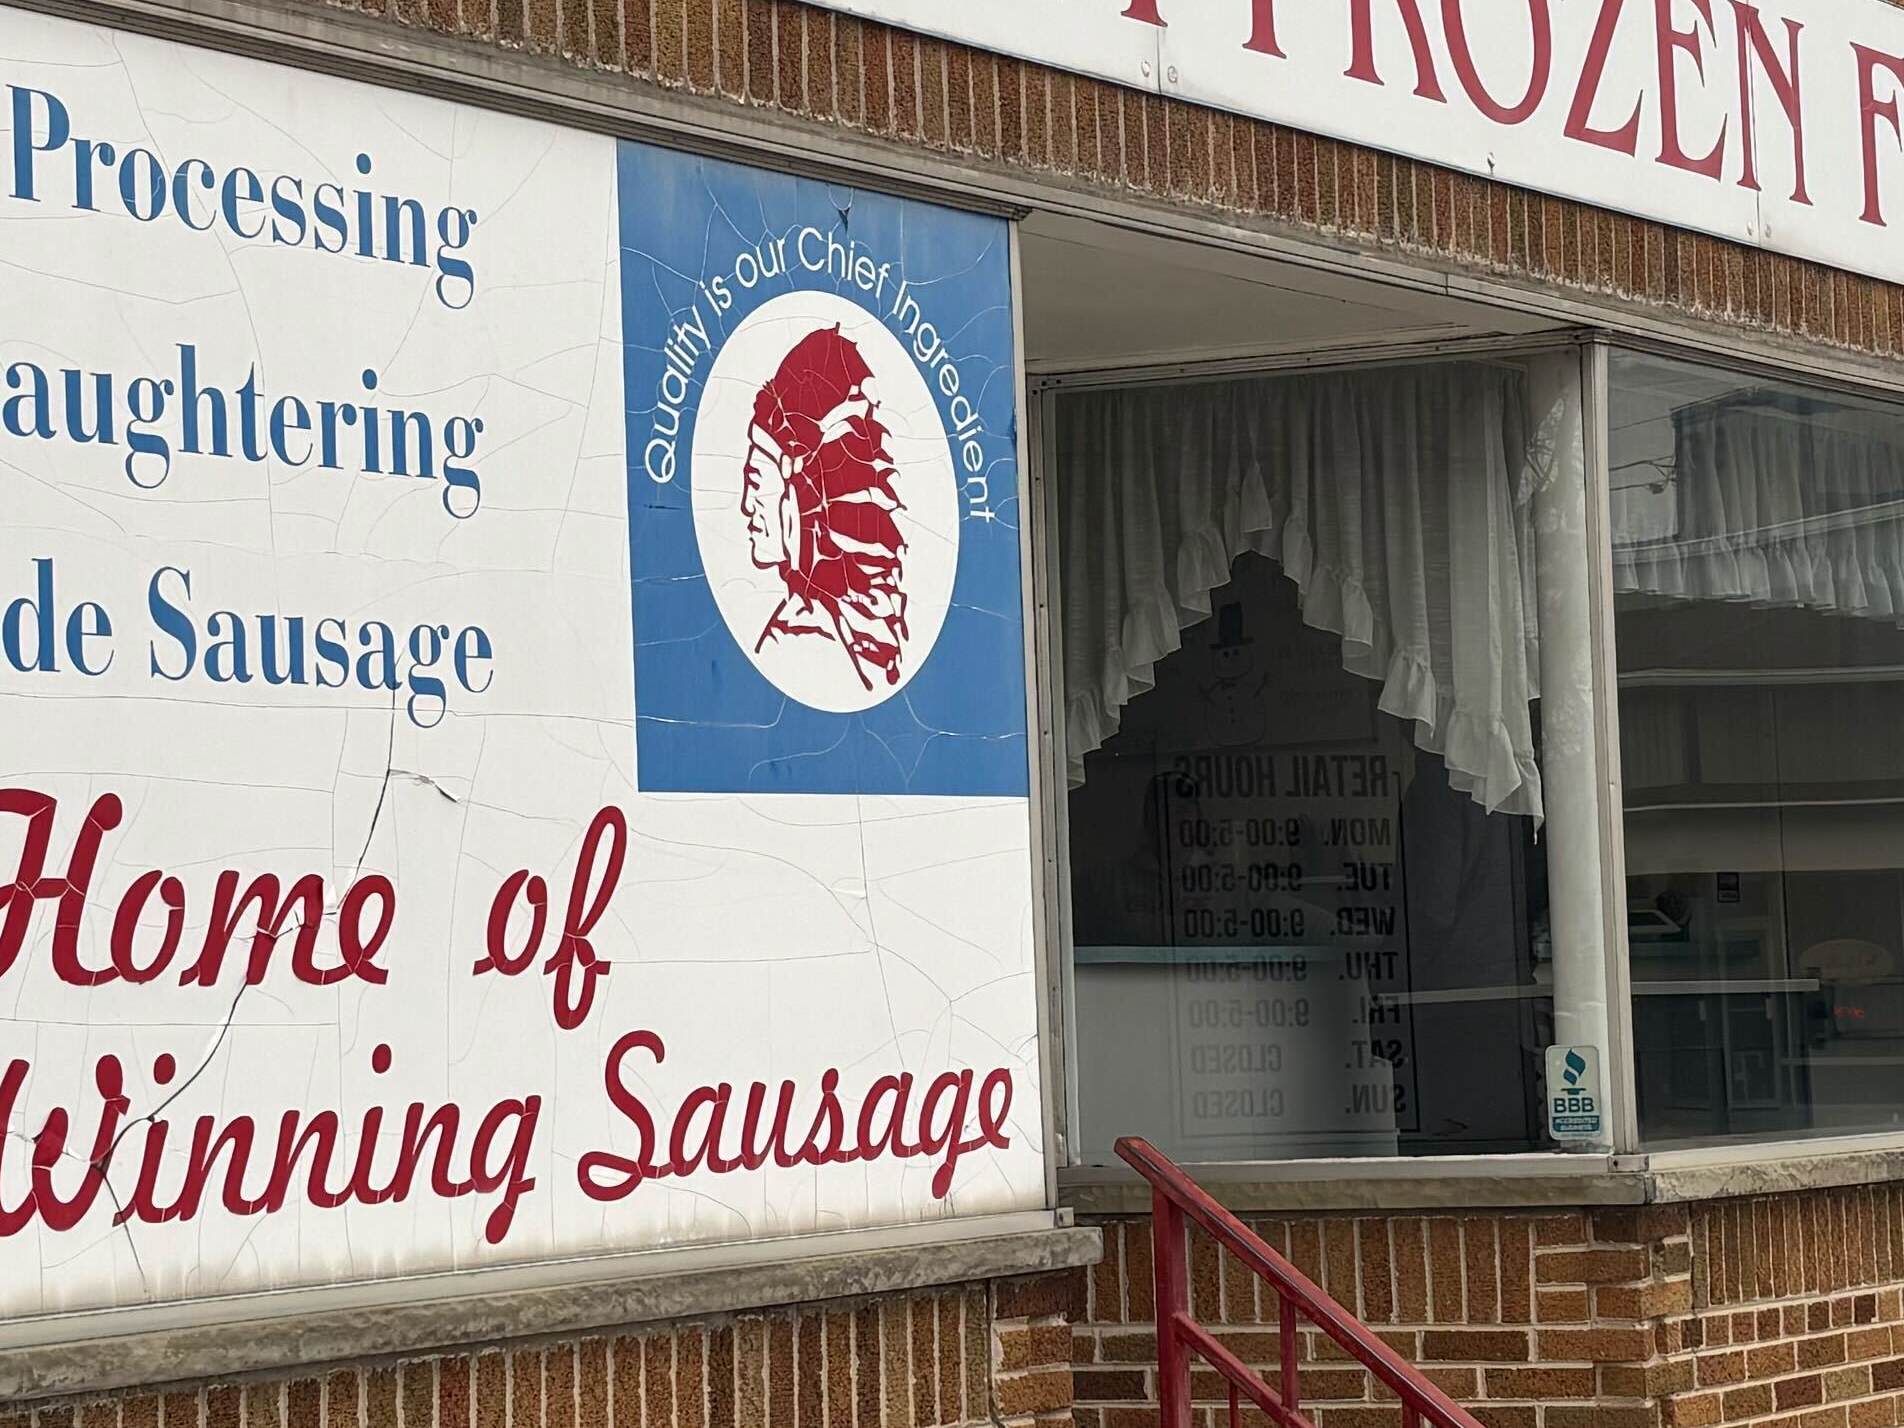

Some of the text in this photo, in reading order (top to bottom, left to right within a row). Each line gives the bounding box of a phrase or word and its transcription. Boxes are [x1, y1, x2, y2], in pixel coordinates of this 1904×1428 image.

[6, 83, 480, 311] Processing
[643, 225, 999, 525] Quality is our Chief Ingredient
[147, 565, 496, 729] Sausage
[473, 803, 632, 1032] of
[577, 1027, 1016, 1204] Sausage
[1553, 1097, 1595, 1114] BBB
